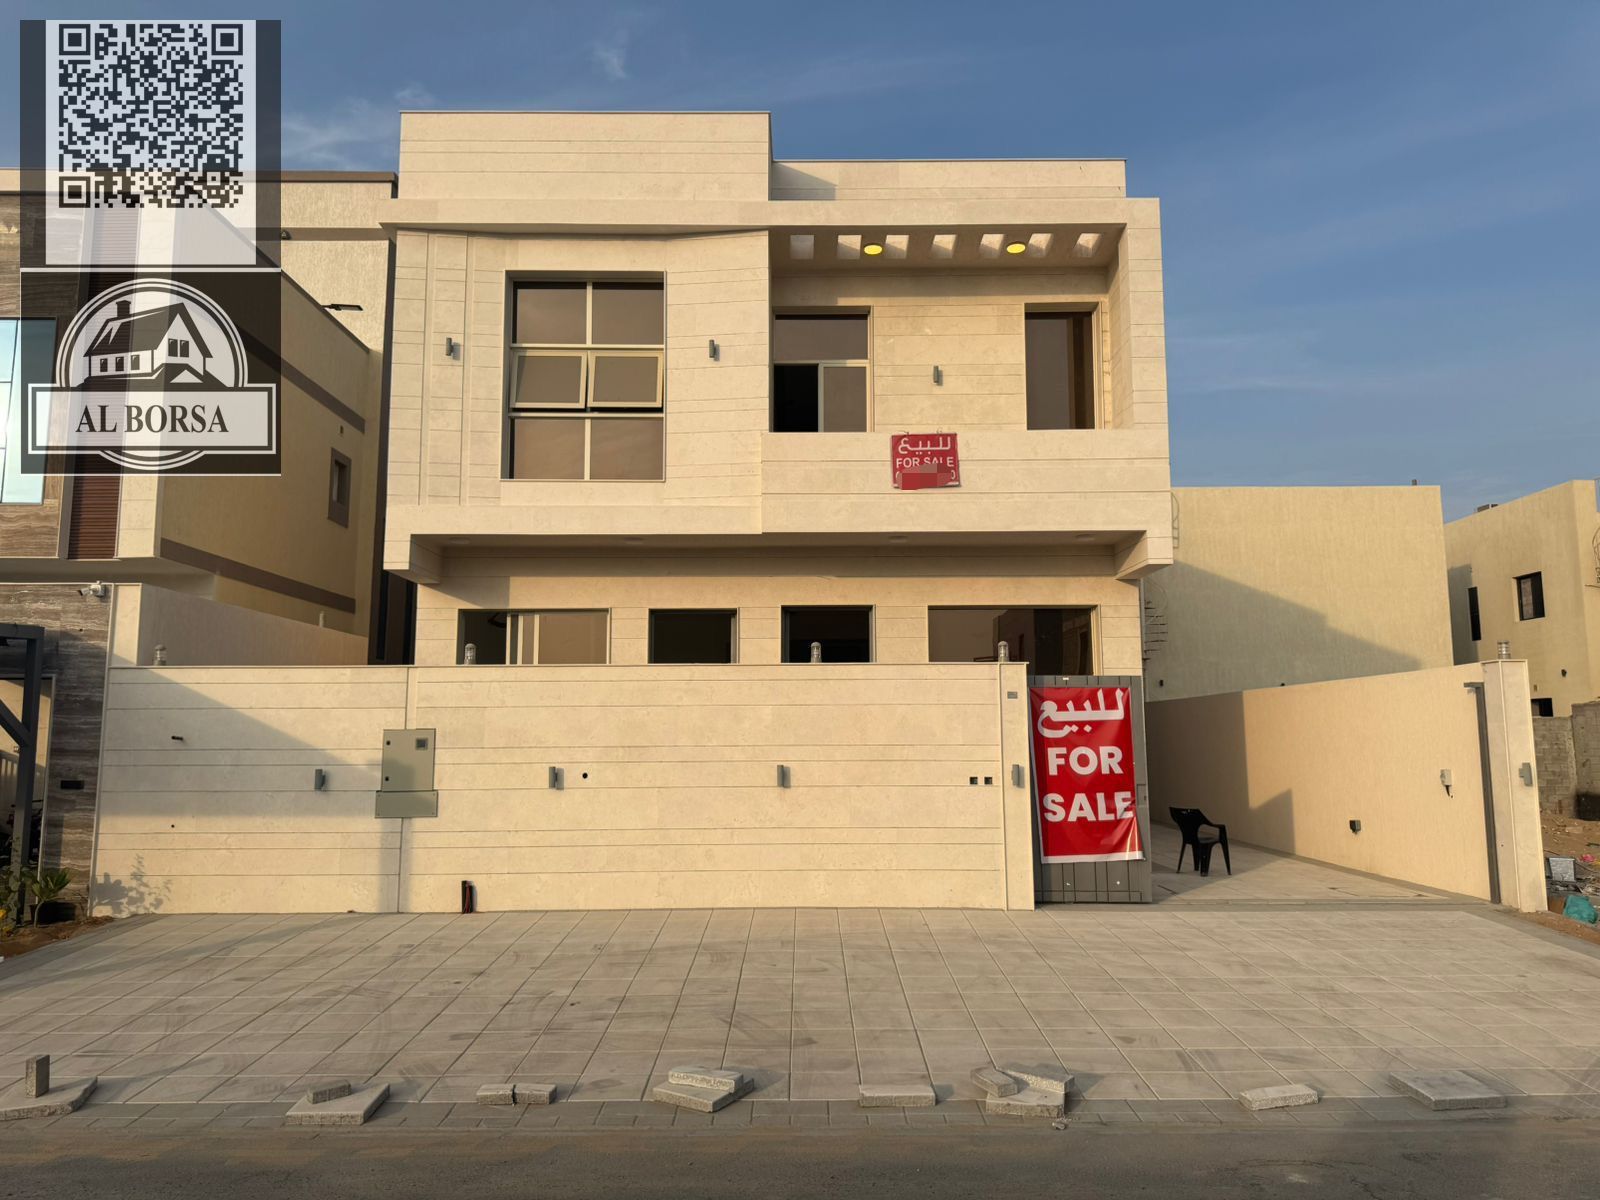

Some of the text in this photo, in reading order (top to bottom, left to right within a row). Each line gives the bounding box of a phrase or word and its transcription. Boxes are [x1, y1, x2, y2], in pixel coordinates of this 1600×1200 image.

[898, 436, 951, 455] للبيع
[896, 457, 920, 468] FOR
[1037, 688, 1125, 738] للبيع
[1047, 745, 1124, 776] FOR
[1042, 791, 1134, 823] SALE
